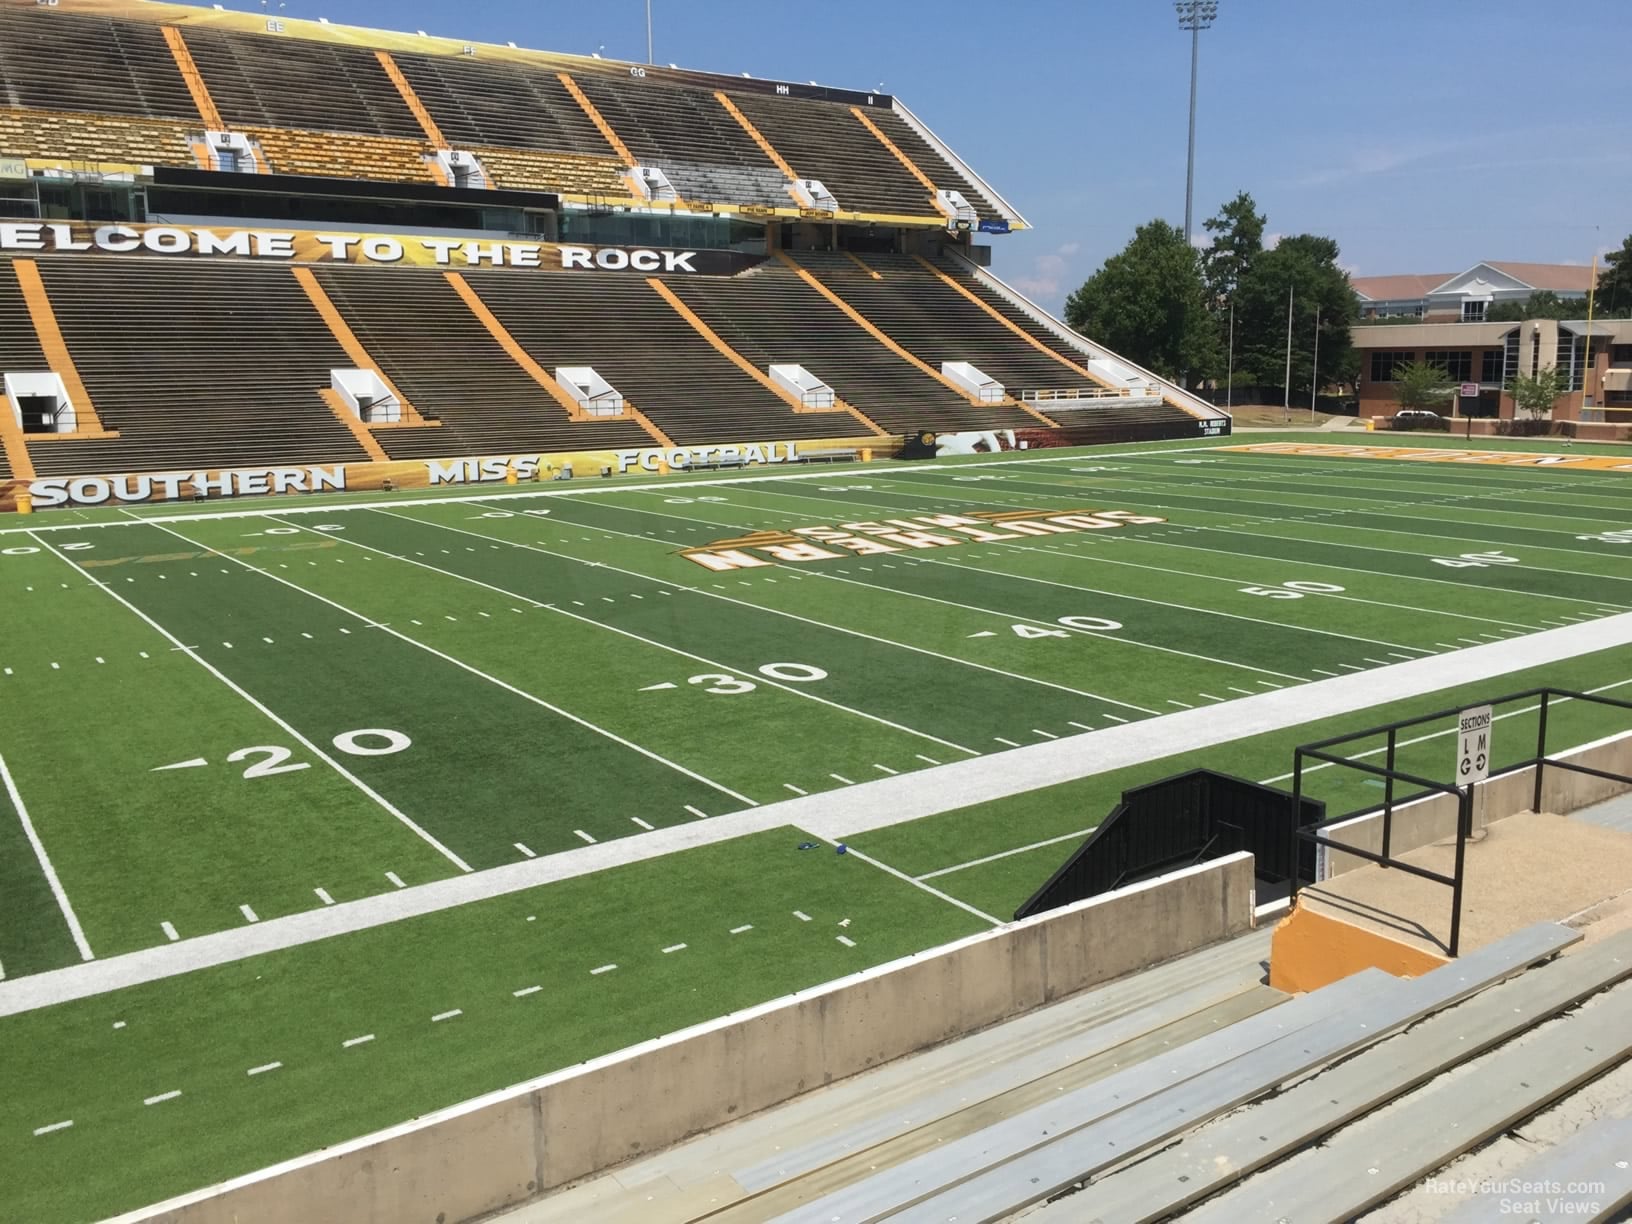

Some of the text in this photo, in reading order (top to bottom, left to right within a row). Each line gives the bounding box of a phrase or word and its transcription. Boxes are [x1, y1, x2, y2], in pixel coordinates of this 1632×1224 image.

[266, 20, 285, 32] EE
[776, 84, 789, 95] HH
[315, 235, 404, 261] TO
[421, 240, 541, 267] THE
[557, 247, 697, 273] ROCK
[29, 441, 799, 506] SOUTHERN MISS FOOTBALL
[679, 510, 1168, 572] SOUTHERN
[1237, 580, 1346, 600] 50
[1011, 615, 1123, 639] 40
[687, 662, 829, 695] 30
[1461, 713, 1490, 730] SECTIONS
[226, 727, 412, 779] 20
[1464, 733, 1486, 755] L M
